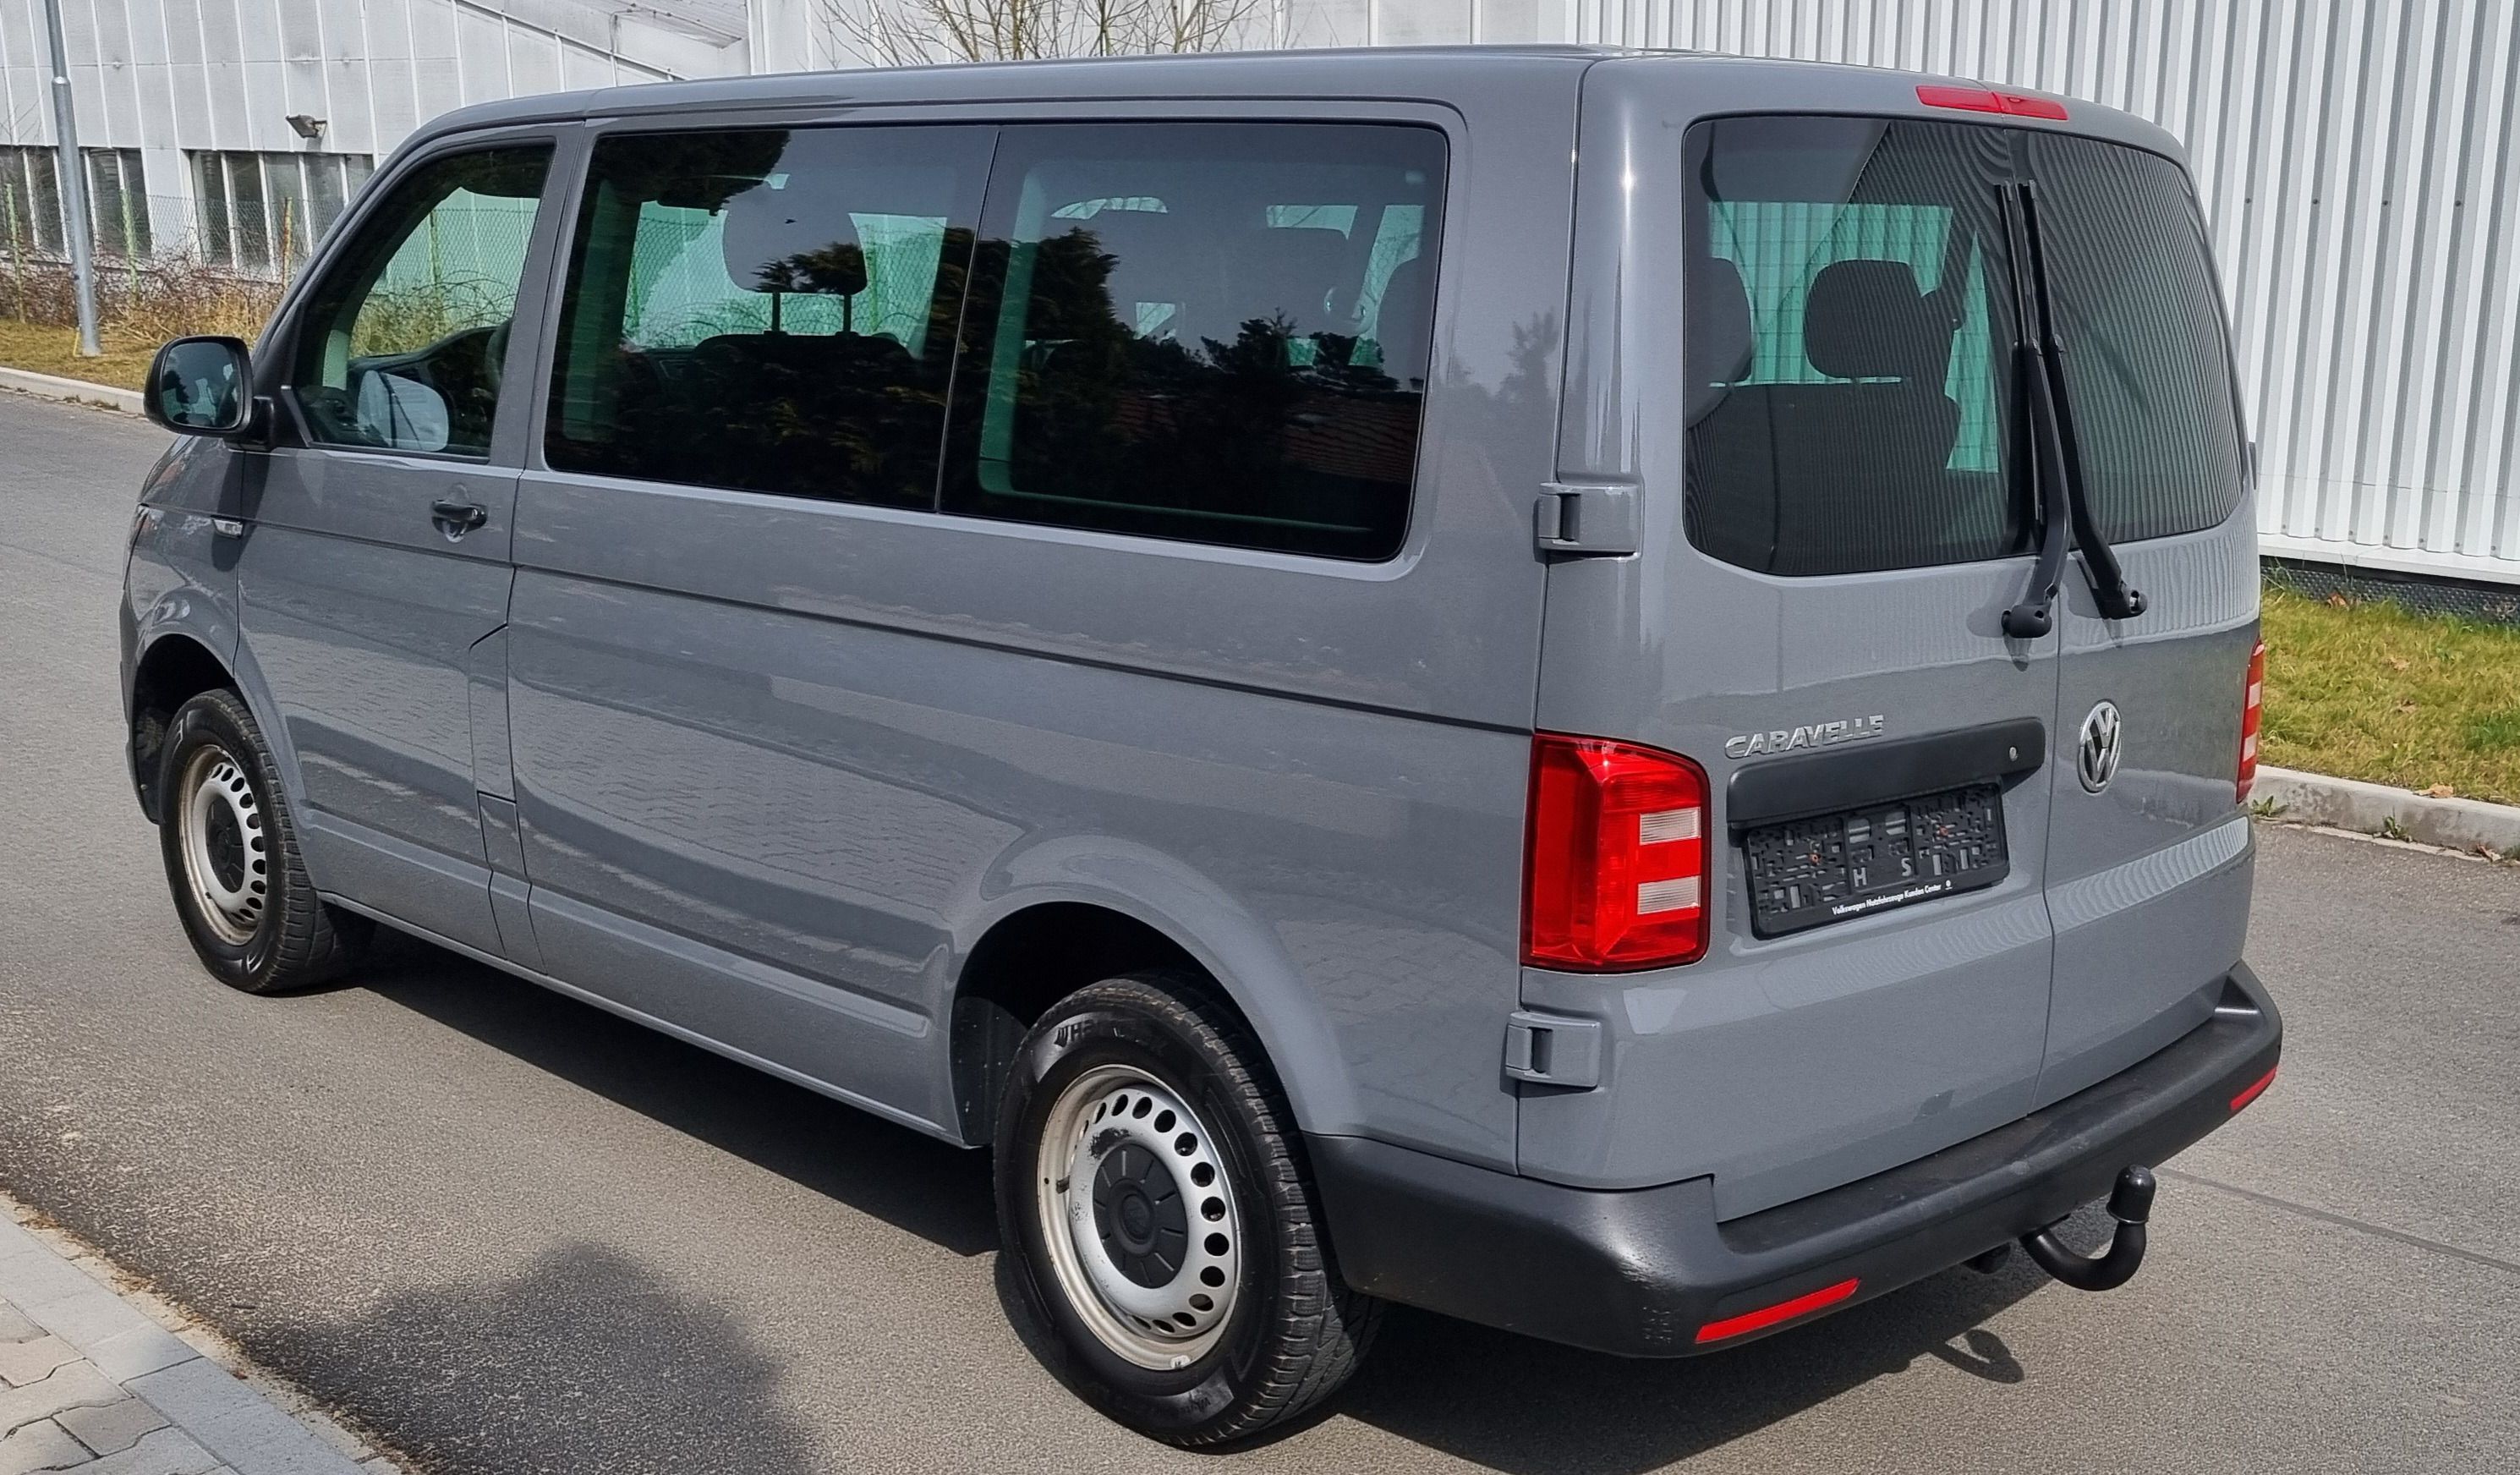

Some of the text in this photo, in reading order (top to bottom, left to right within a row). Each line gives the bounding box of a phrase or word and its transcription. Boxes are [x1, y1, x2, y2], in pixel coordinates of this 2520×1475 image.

[1724, 715, 1884, 759] CARAVELLE
[1832, 902, 1866, 915] Volkswagen
[1924, 884, 1942, 894] Center
